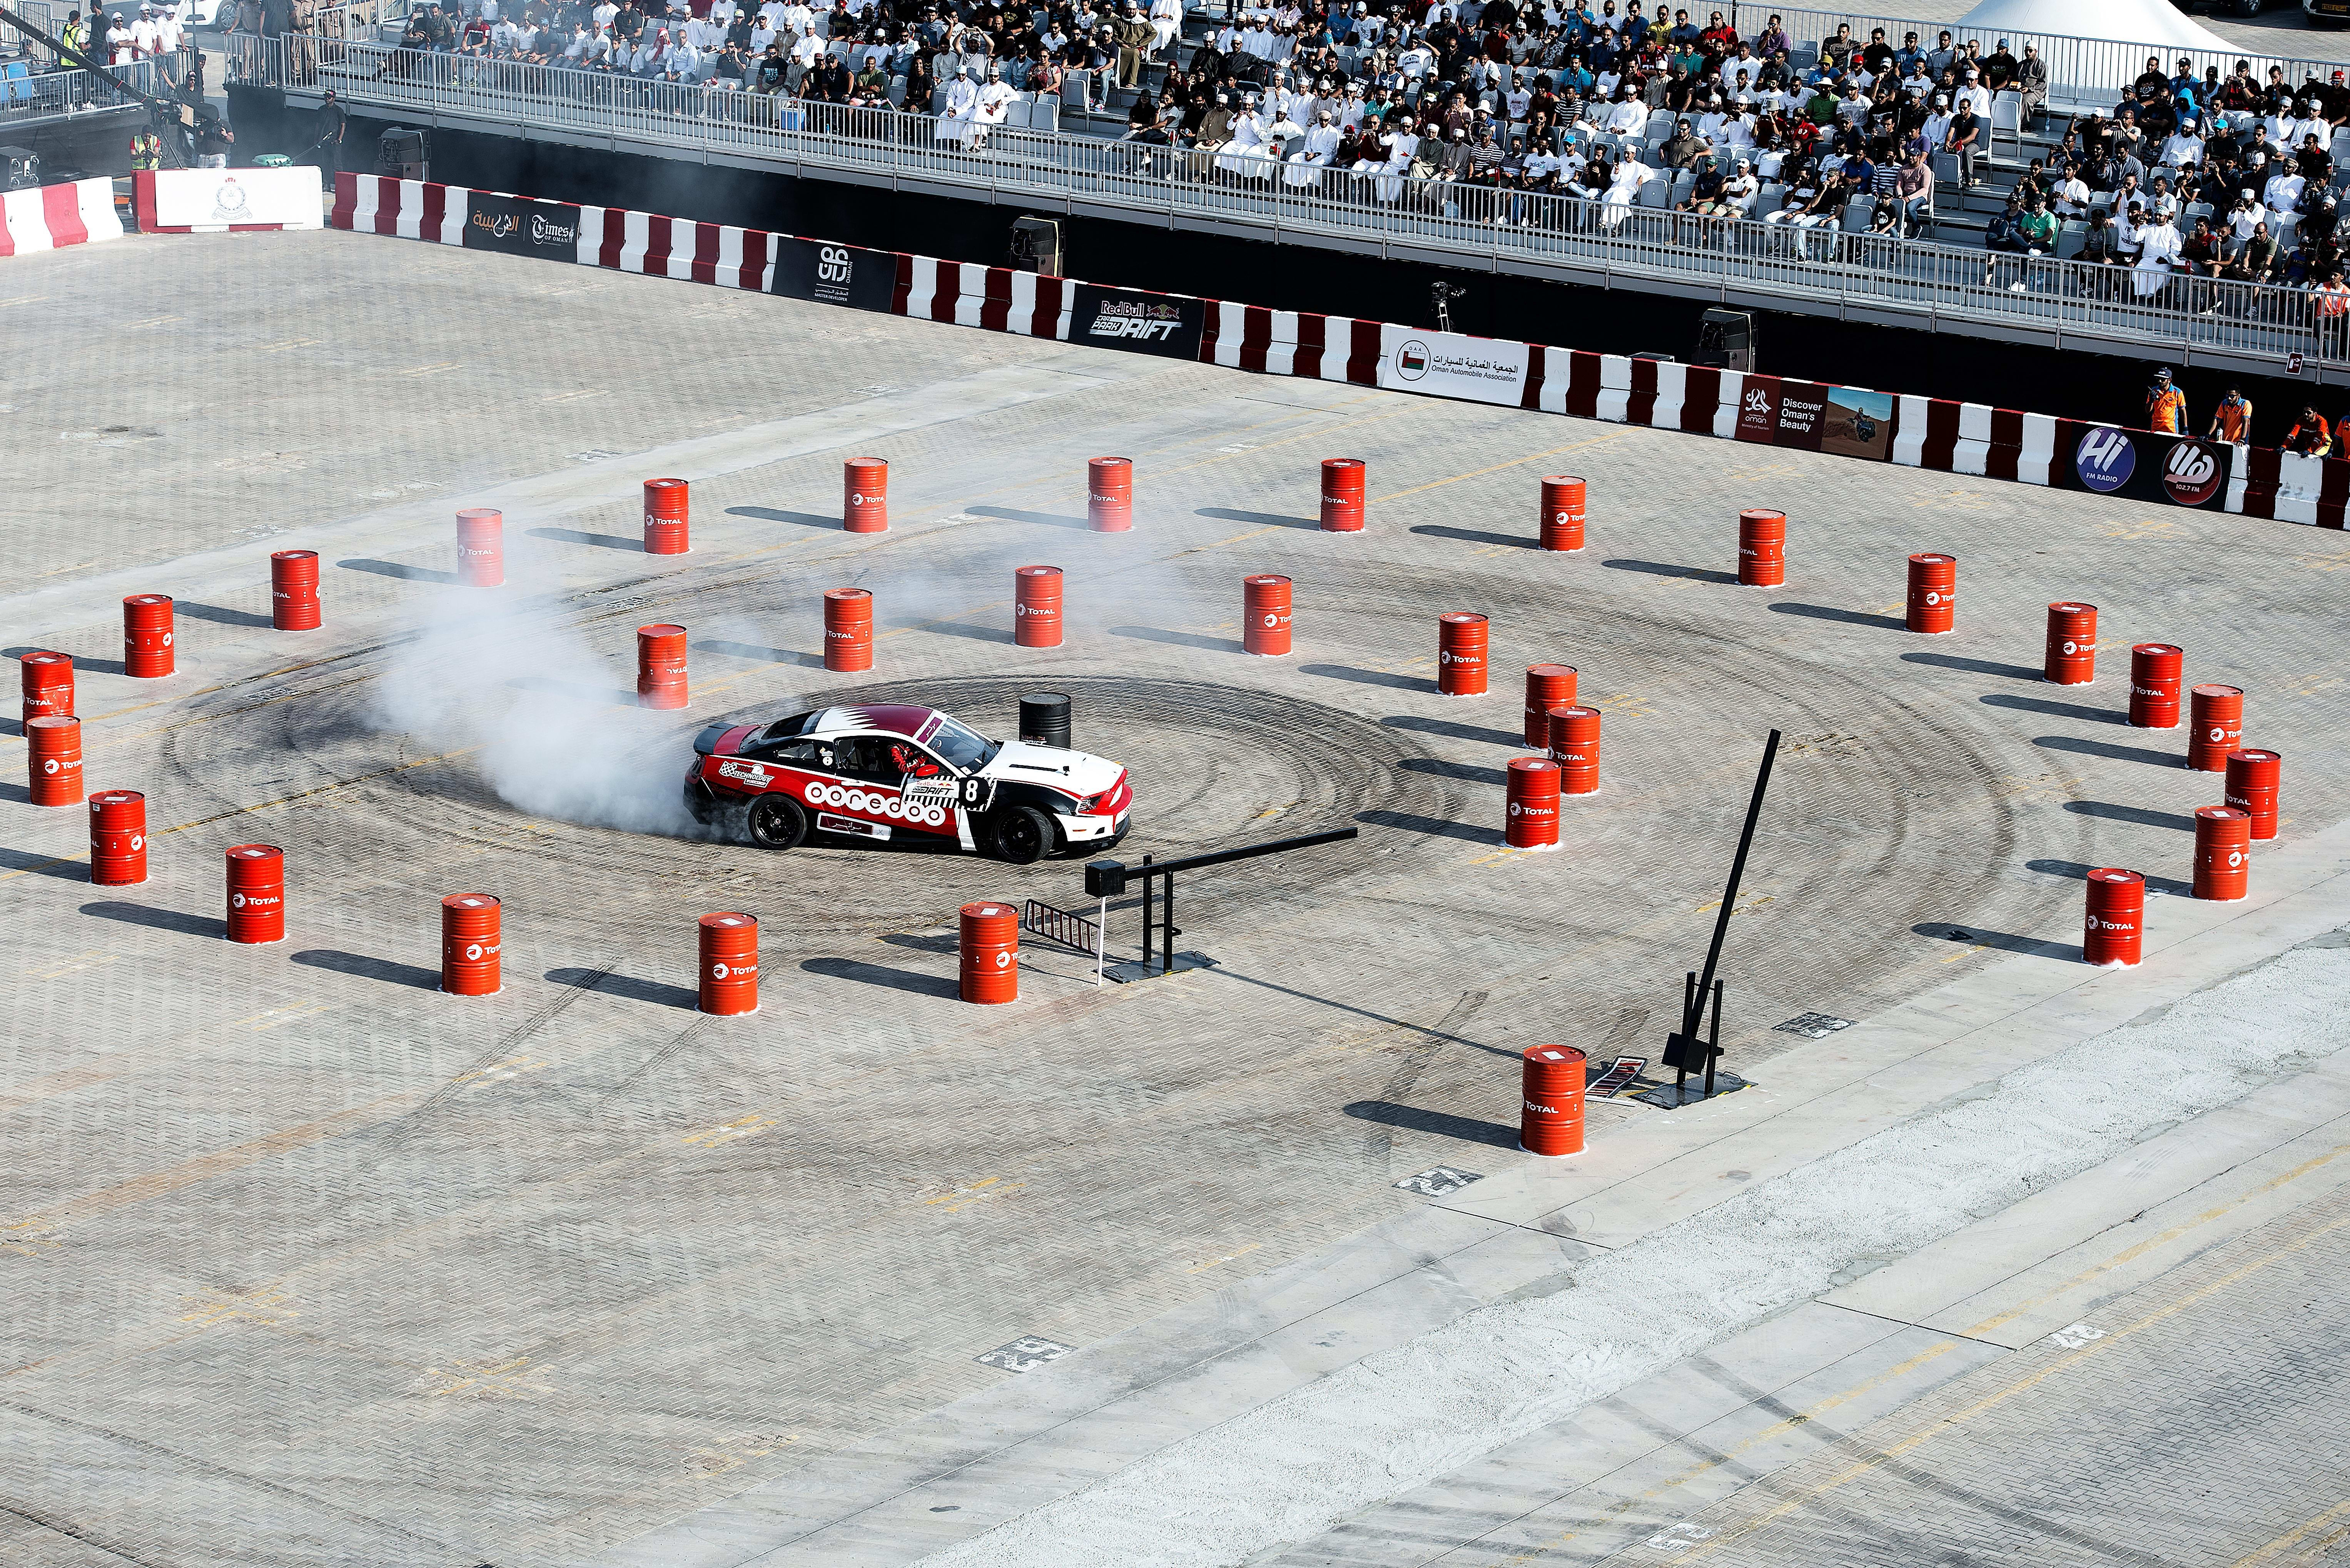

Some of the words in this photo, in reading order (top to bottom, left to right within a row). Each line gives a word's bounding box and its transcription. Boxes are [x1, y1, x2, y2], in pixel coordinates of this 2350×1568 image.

[532, 214, 569, 240] Times
[1101, 300, 1123, 315] Red
[1123, 302, 1144, 317] Bull
[1089, 316, 1182, 340] DRIFT
[1091, 320, 1121, 330] PARK
[1433, 355, 1463, 367] للسيارات
[1431, 365, 1448, 374] Oman
[1450, 367, 1482, 377] Automobile
[1483, 372, 1517, 382] Association
[1493, 361, 1518, 375] الجمعية
[1783, 398, 1822, 411] Discover
[1745, 416, 1767, 424] oman
[1781, 408, 1815, 421] Oman's
[1780, 419, 1811, 432] Beauty
[2077, 430, 2129, 472] Hi
[2097, 474, 2118, 482] RADIO
[1324, 496, 1348, 504] TOTAL
[828, 630, 854, 639] TOTAL
[2136, 686, 2165, 696] TOTAL
[26, 697, 53, 706] TOTAL
[1556, 752, 1586, 761] TOTAL
[733, 770, 772, 782] TECHNOLOGY
[912, 786, 954, 795] DRIFT
[965, 780, 978, 802] 8
[809, 785, 941, 823] ooredoo
[1523, 807, 1554, 815] TOTAL
[248, 896, 280, 905] TOTAL
[2101, 921, 2135, 930] TOTAL
[1525, 1100, 1559, 1113] TOTAL
